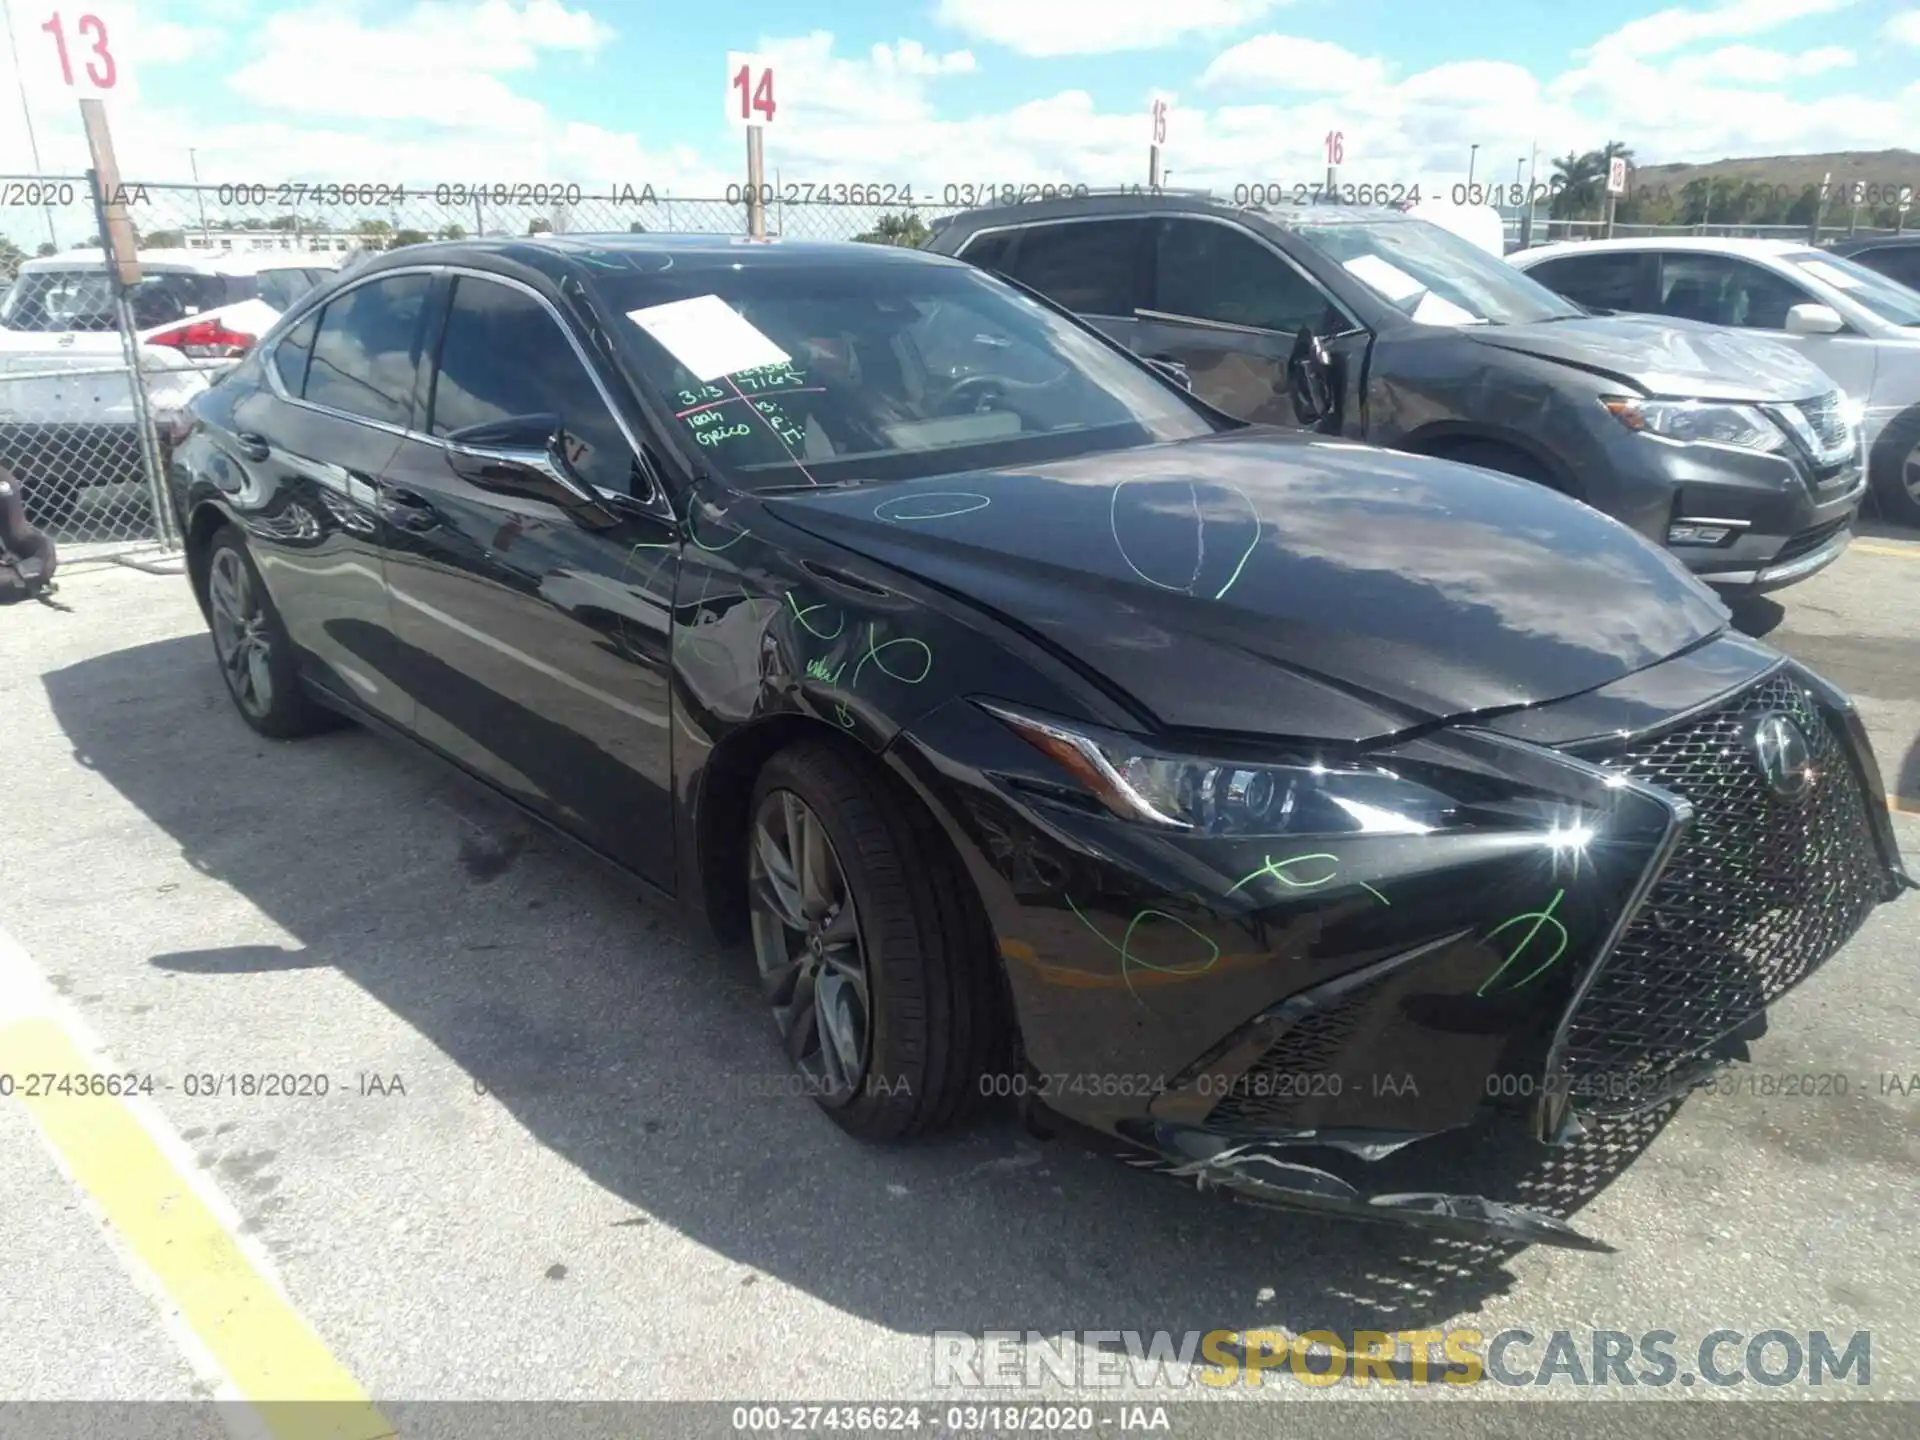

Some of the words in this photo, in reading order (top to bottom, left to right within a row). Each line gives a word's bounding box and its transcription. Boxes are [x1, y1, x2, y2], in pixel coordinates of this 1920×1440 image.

[42, 11, 117, 89] 13
[733, 65, 777, 122] 14
[1152, 99, 1167, 144] 15
[1325, 130, 1344, 164] 16
[678, 385, 724, 405] 3.13
